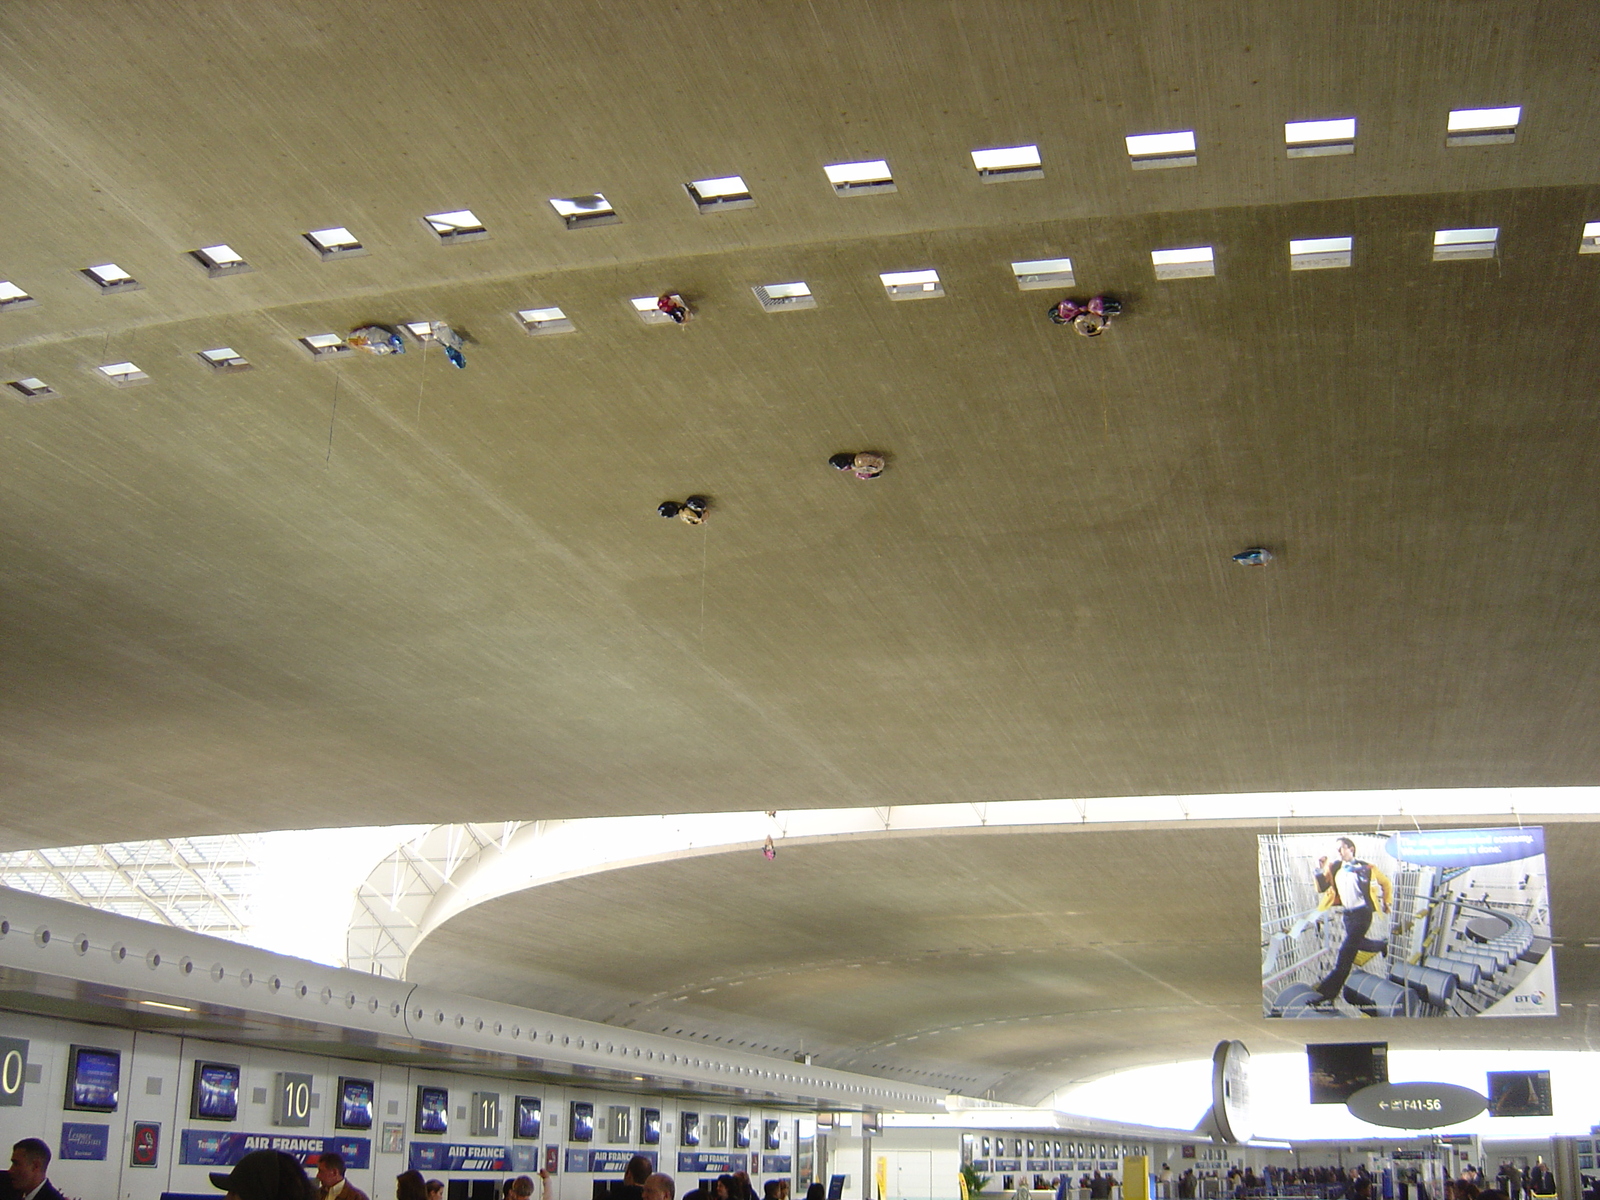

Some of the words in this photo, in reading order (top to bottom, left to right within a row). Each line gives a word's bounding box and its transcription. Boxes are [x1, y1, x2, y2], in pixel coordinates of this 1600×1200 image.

[1515, 995, 1530, 1003] BT
[286, 1082, 309, 1118] 10
[1404, 1099, 1442, 1111] F41-56
[482, 1099, 495, 1129] 11
[617, 1112, 628, 1138] 11
[717, 1121, 726, 1142] 11
[244, 1136, 270, 1149] AIR
[272, 1138, 324, 1151] FRANCE
[448, 1146, 466, 1157] AIR
[468, 1147, 505, 1158] FRANCE
[595, 1152, 607, 1160] AIR
[698, 1154, 708, 1163] AIR
[709, 1155, 730, 1163] FRANCE
